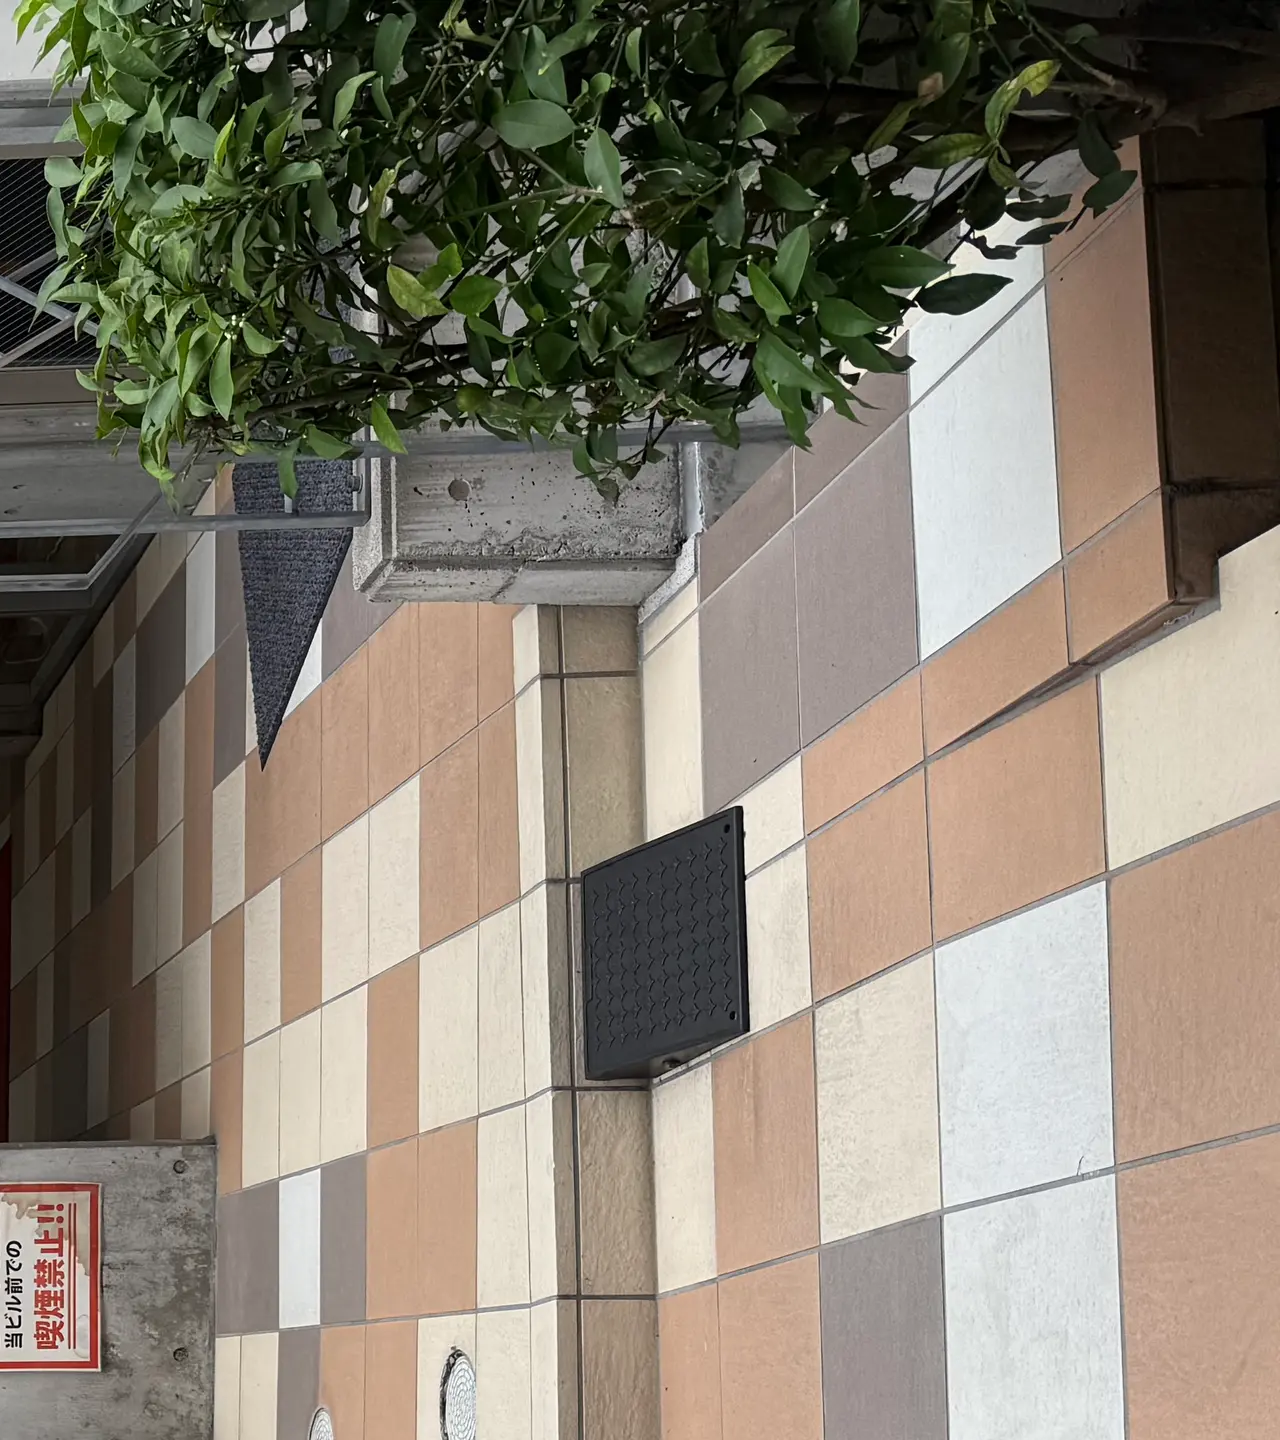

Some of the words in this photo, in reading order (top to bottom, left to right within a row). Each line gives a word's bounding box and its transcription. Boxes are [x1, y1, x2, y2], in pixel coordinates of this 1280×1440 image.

[4, 1240, 24, 1350] 当ビル前での
[33, 1202, 66, 1350] 喫煙禁止!!
